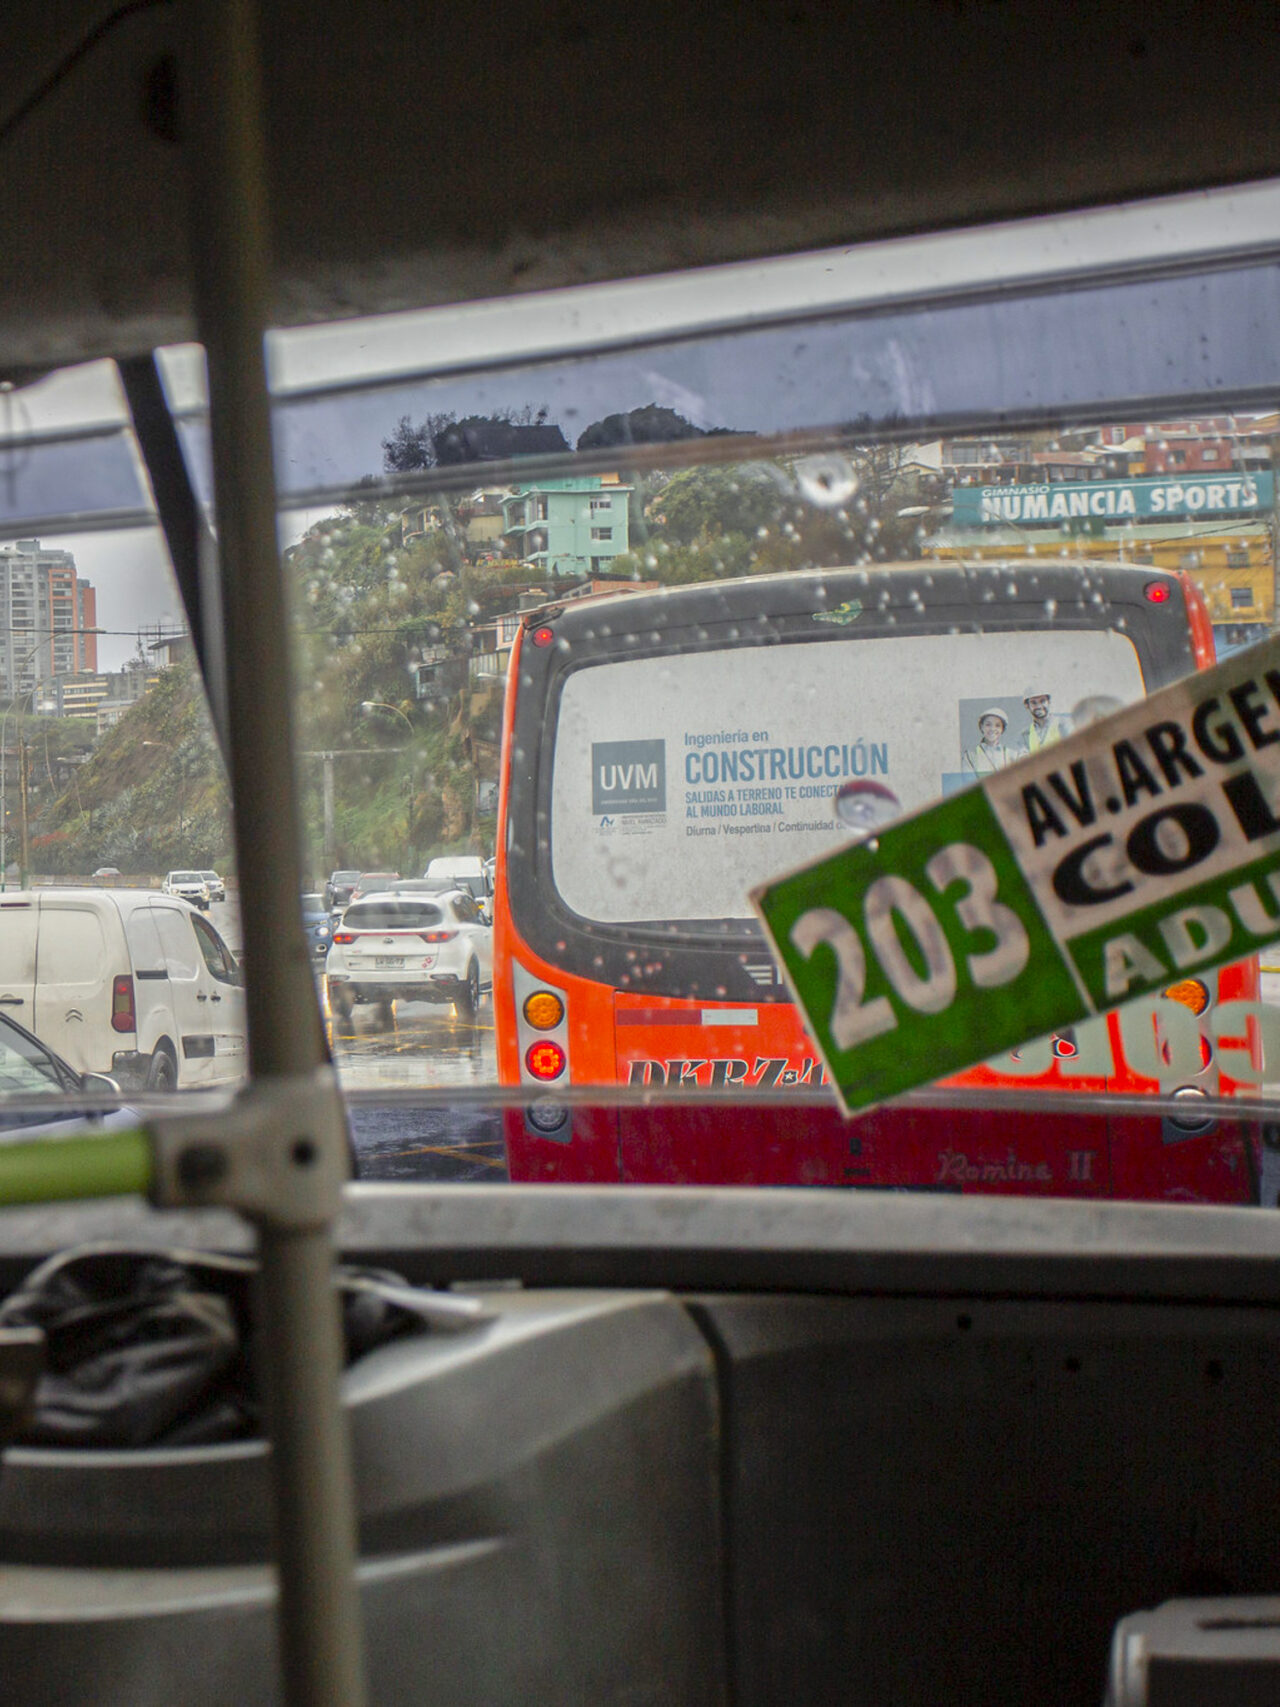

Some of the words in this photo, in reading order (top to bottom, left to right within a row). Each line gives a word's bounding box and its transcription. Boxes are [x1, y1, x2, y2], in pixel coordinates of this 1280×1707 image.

[981, 485, 1050, 498] GIMNASIO
[981, 489, 1136, 522] NUMANCIA
[1150, 481, 1258, 512] SPORTS
[684, 729, 749, 748] Ingeniería
[752, 731, 768, 742] en
[685, 737, 888, 784] CONSTRUCCIÓN
[600, 763, 657, 790] UVM
[685, 790, 725, 804] SALIDAS
[727, 789, 735, 802] A
[737, 787, 782, 801] TERRENO
[784, 786, 797, 799] TE
[686, 805, 698, 818] AL
[700, 804, 737, 817] MUNDO
[739, 801, 784, 816] LABORAL
[723, 822, 771, 836] Vespertina
[778, 819, 834, 832] Continuidad
[790, 843, 1030, 1051] 203
